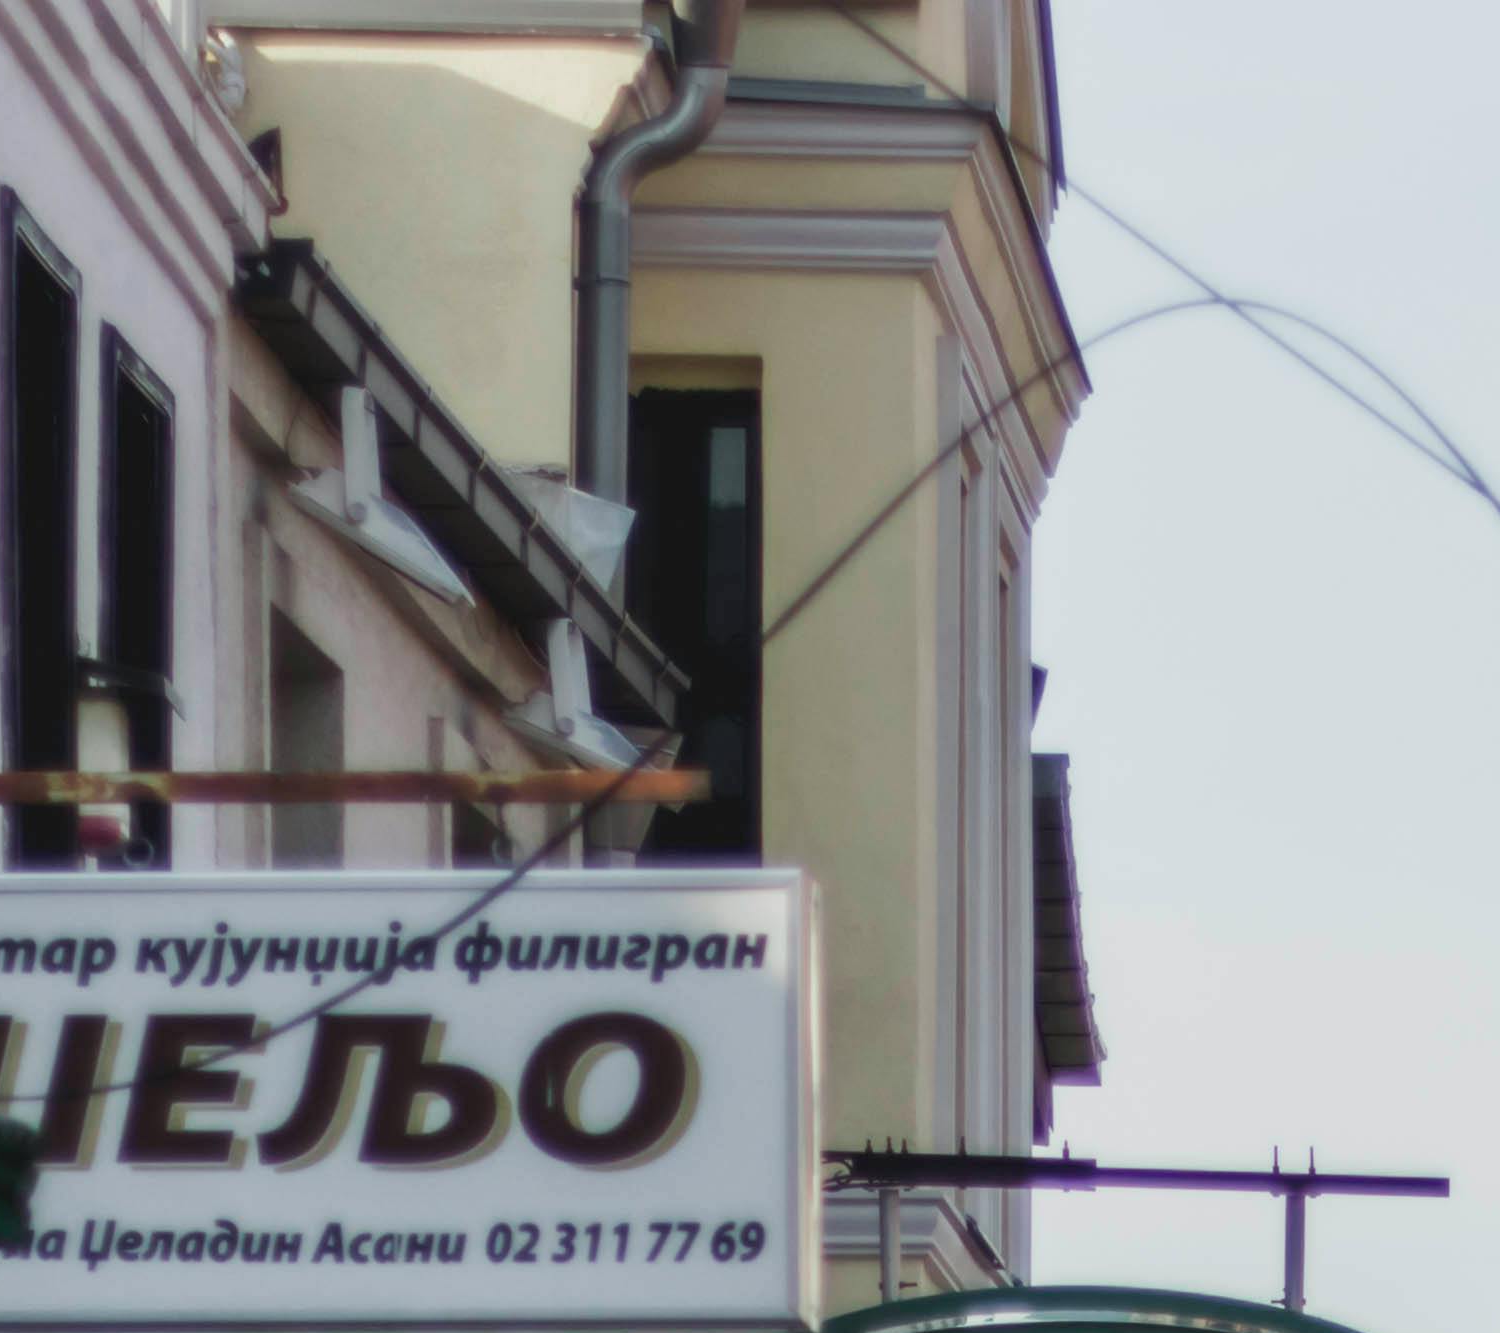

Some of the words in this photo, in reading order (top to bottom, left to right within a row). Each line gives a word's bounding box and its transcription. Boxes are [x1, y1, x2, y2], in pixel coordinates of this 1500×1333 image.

[133, 920, 437, 988] кујунџија
[454, 920, 767, 984] филигран
[315, 1222, 468, 1263] Асани
[484, 1222, 541, 1264] 02
[550, 1222, 632, 1264] 311
[645, 1222, 702, 1264] 77
[708, 1221, 768, 1264] 69
